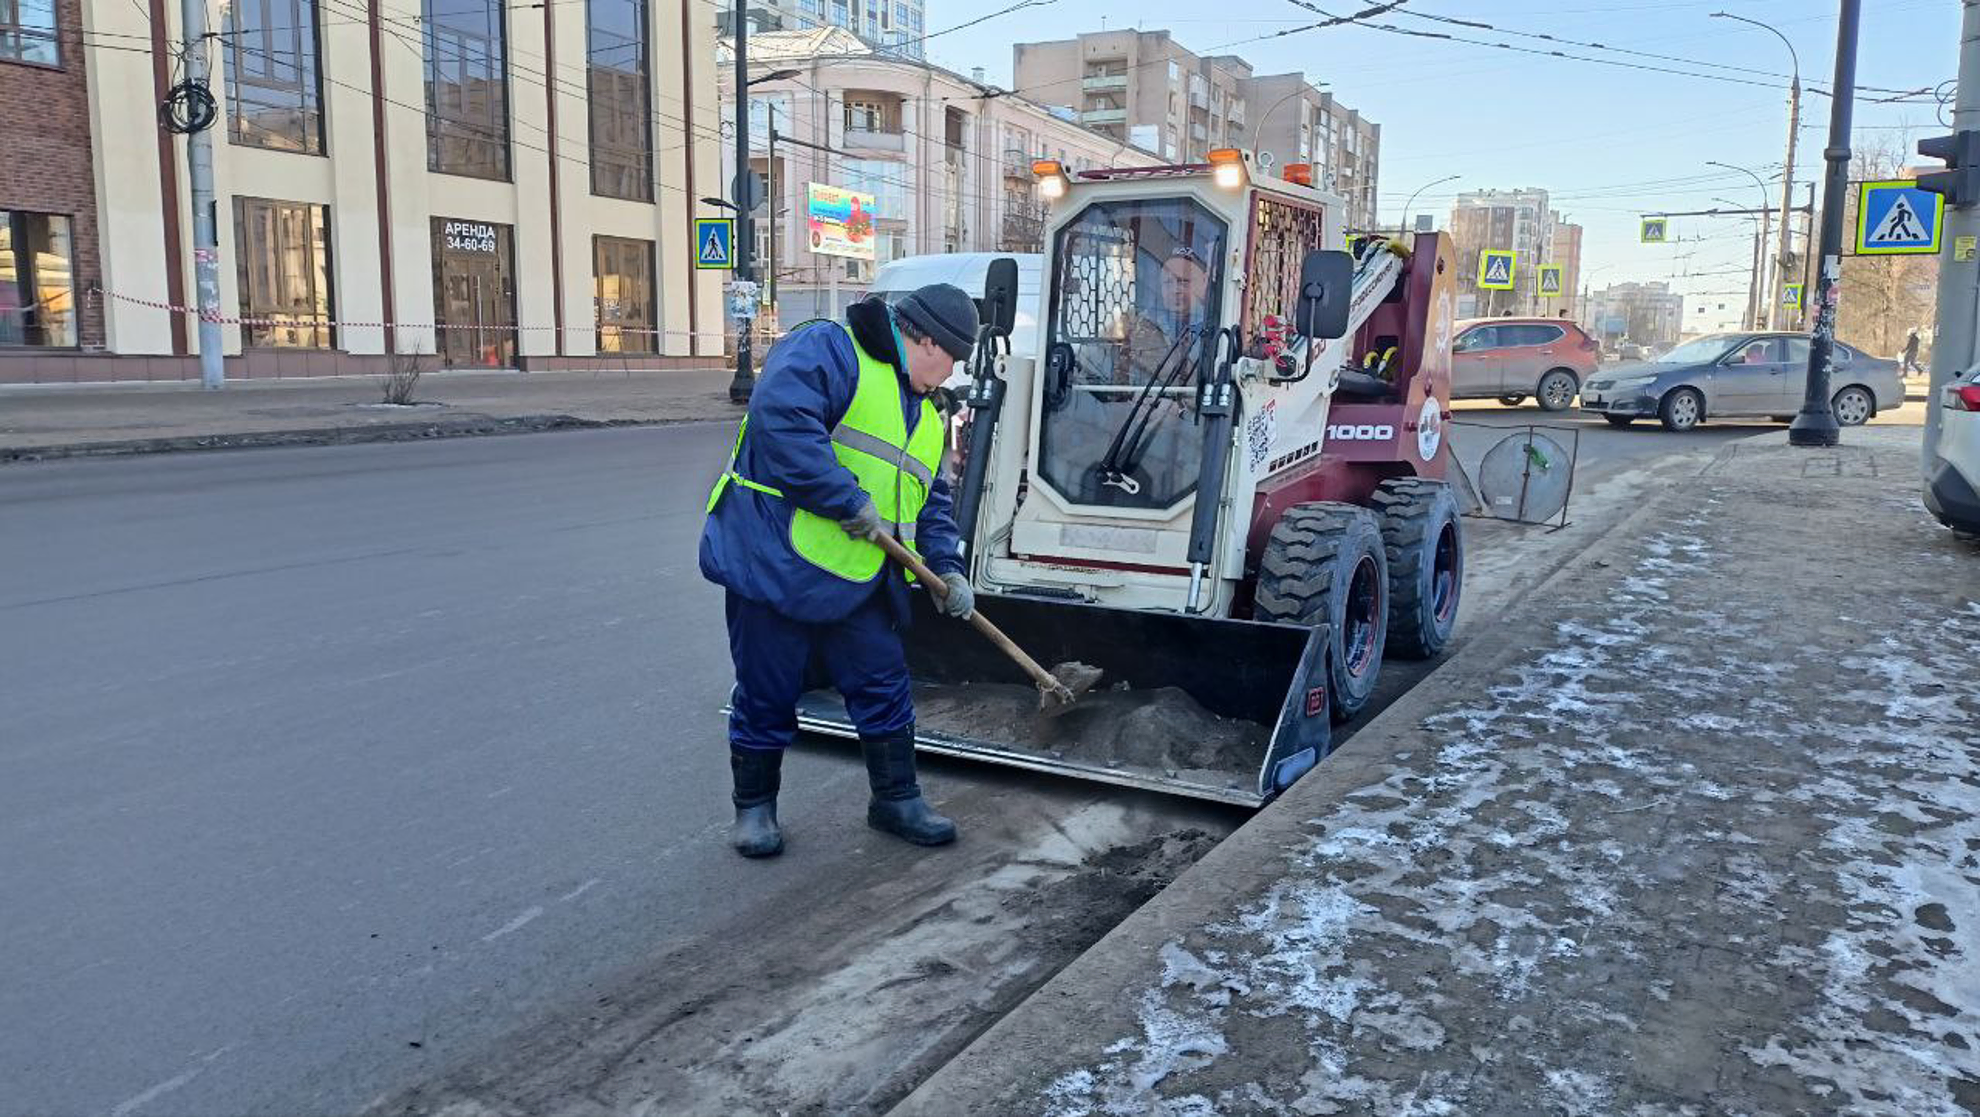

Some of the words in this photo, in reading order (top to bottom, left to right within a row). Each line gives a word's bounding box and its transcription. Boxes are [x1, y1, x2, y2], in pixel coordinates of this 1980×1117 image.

[445, 222, 495, 239] АРЕНДА
[446, 236, 495, 252] 34-60-69
[1327, 425, 1393, 440] 1000
